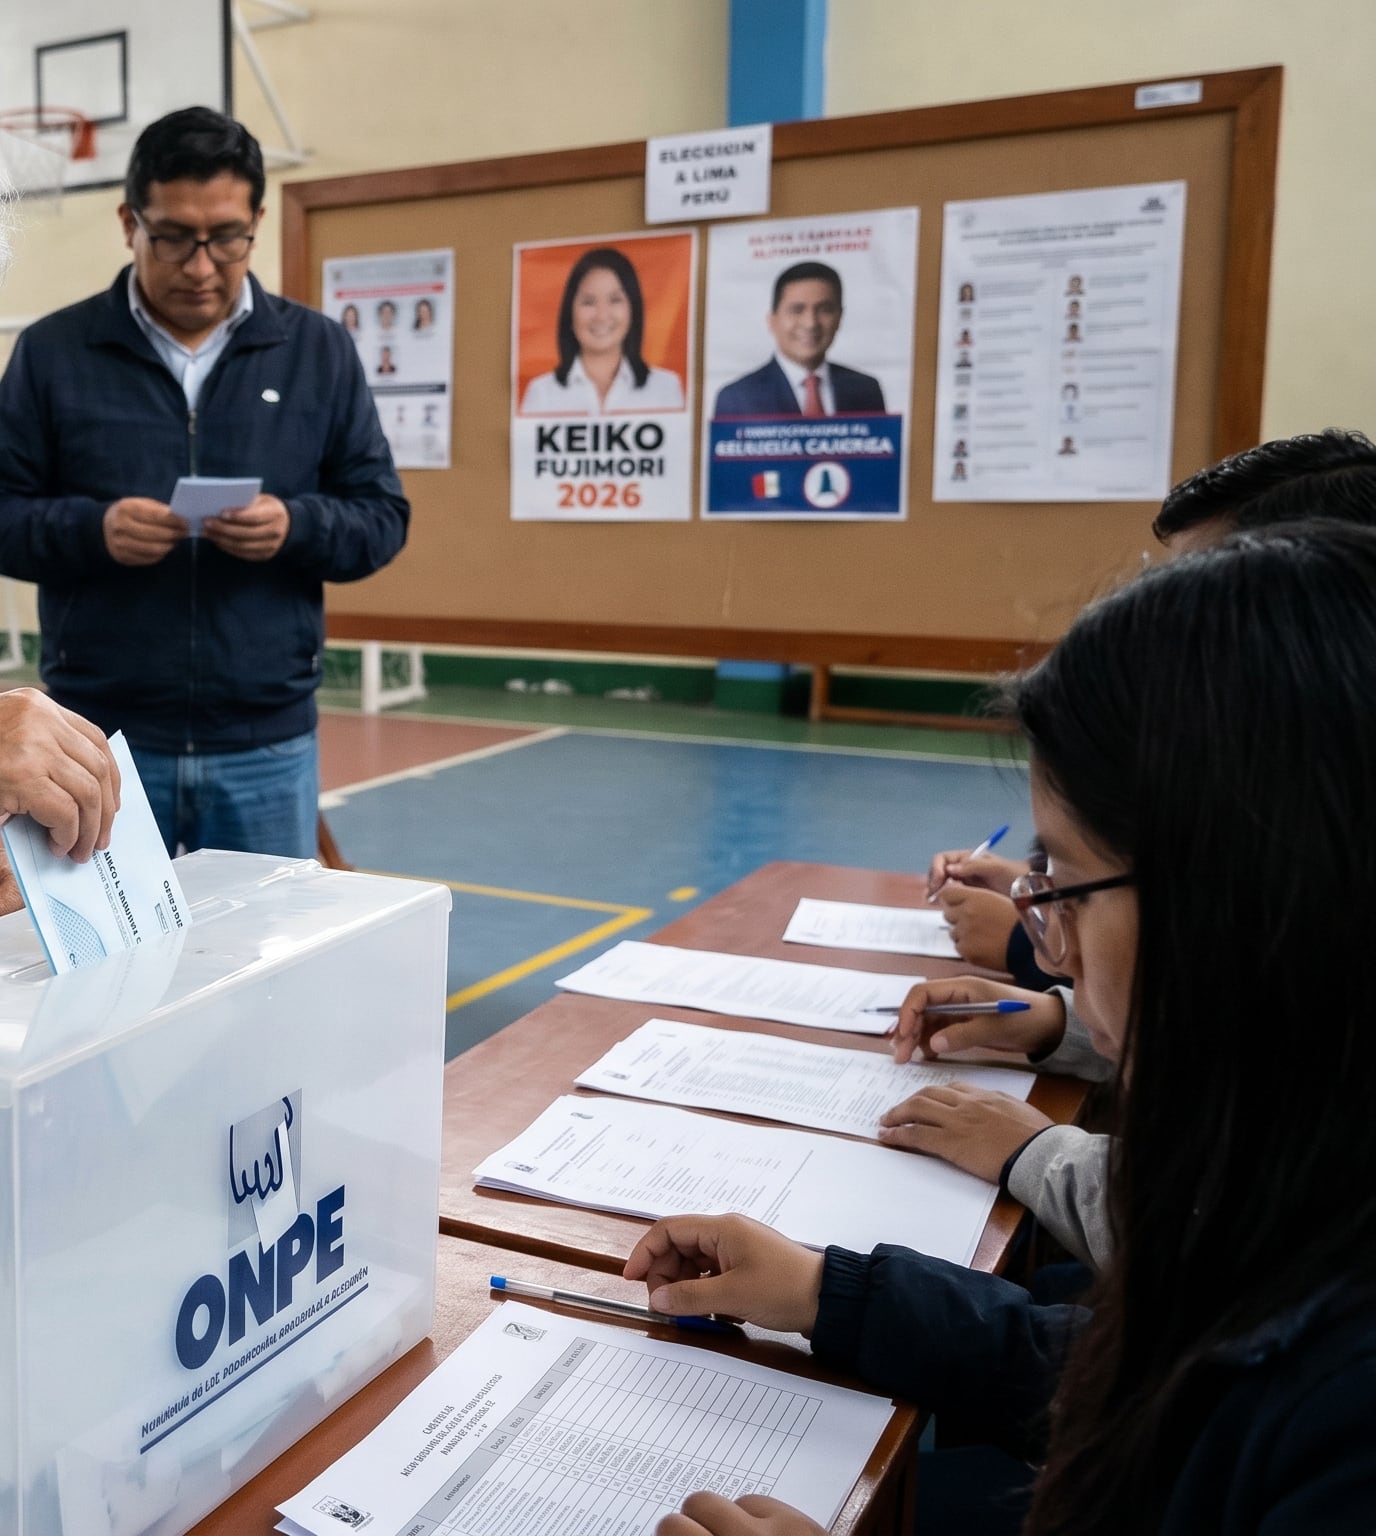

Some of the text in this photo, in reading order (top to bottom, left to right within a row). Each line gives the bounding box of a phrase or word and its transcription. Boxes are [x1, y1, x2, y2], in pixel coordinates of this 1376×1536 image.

[692, 166, 738, 183] LIMA
[536, 423, 664, 453] KEIKO
[534, 458, 665, 478] FUJIMORI
[557, 482, 642, 509] 2026
[175, 1183, 346, 1370] ONPE
